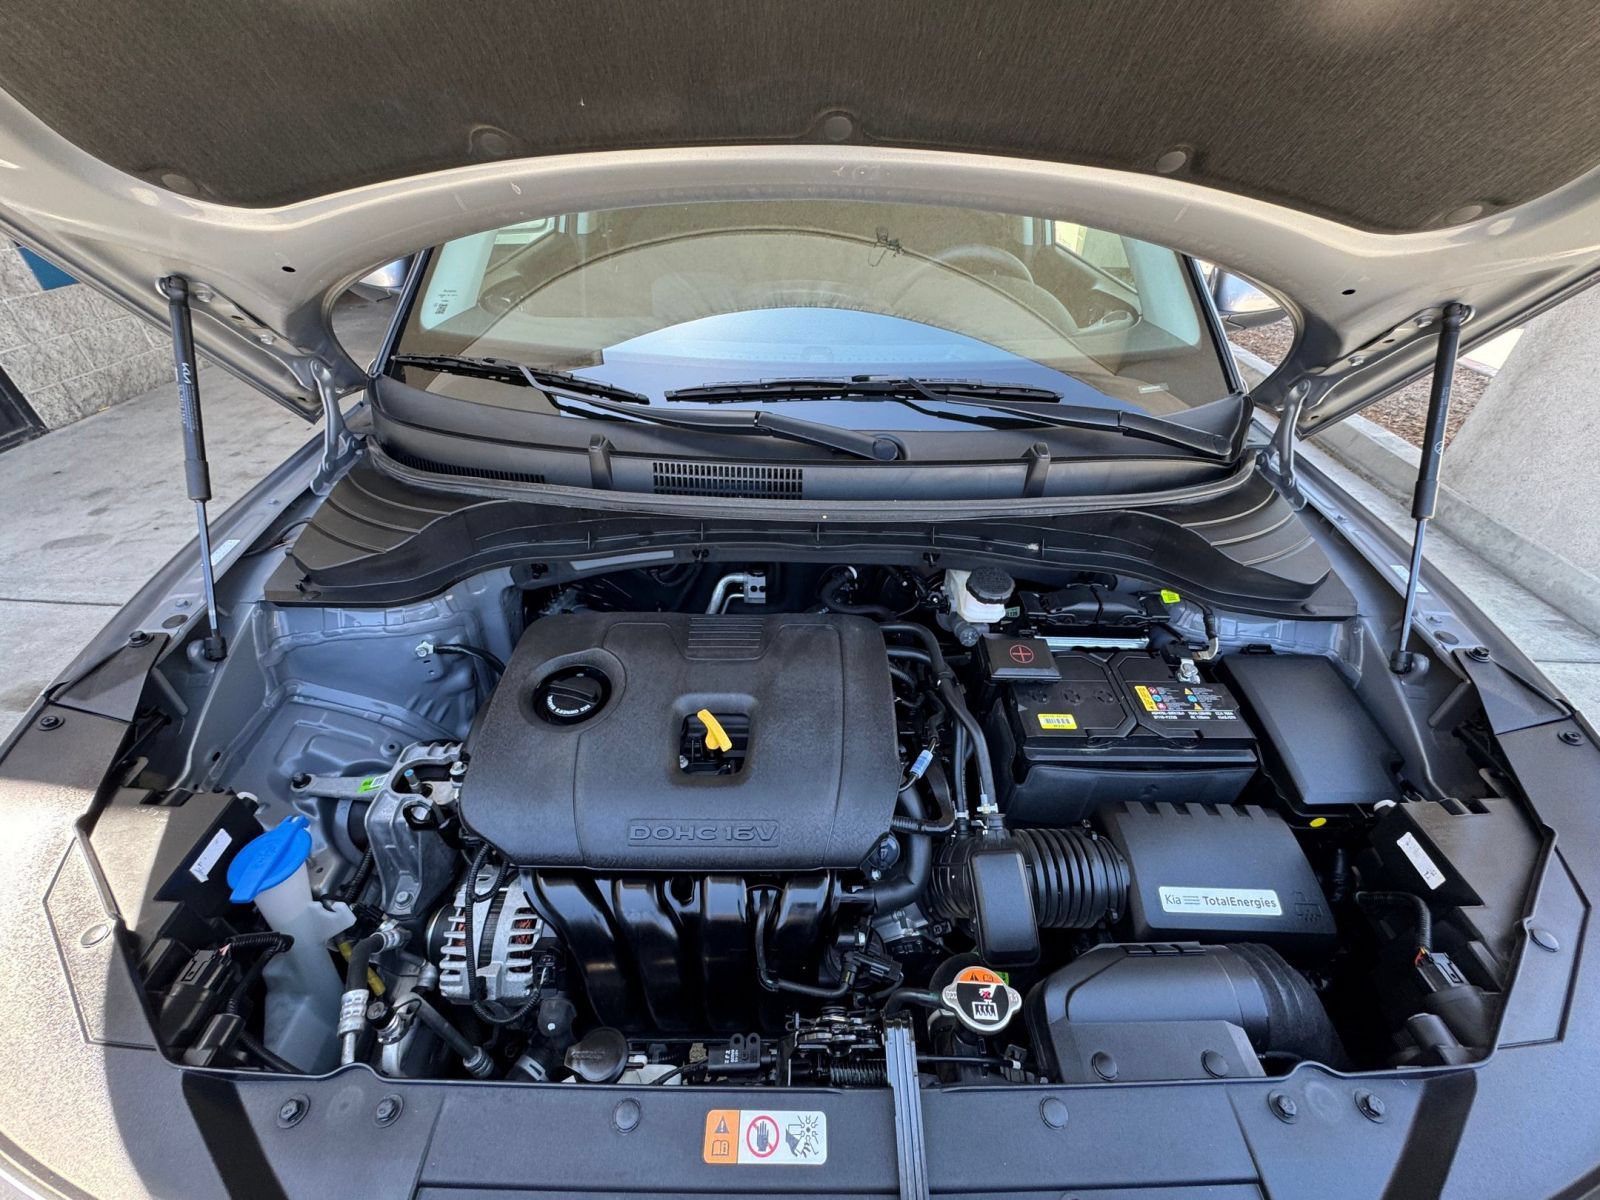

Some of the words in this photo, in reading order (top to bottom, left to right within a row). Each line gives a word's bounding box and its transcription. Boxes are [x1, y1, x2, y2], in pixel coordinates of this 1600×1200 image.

[629, 825, 718, 841] DOHC
[725, 825, 778, 842] 16V
[1164, 894, 1182, 905] Kia
[1202, 895, 1278, 909] TotalEnergies
